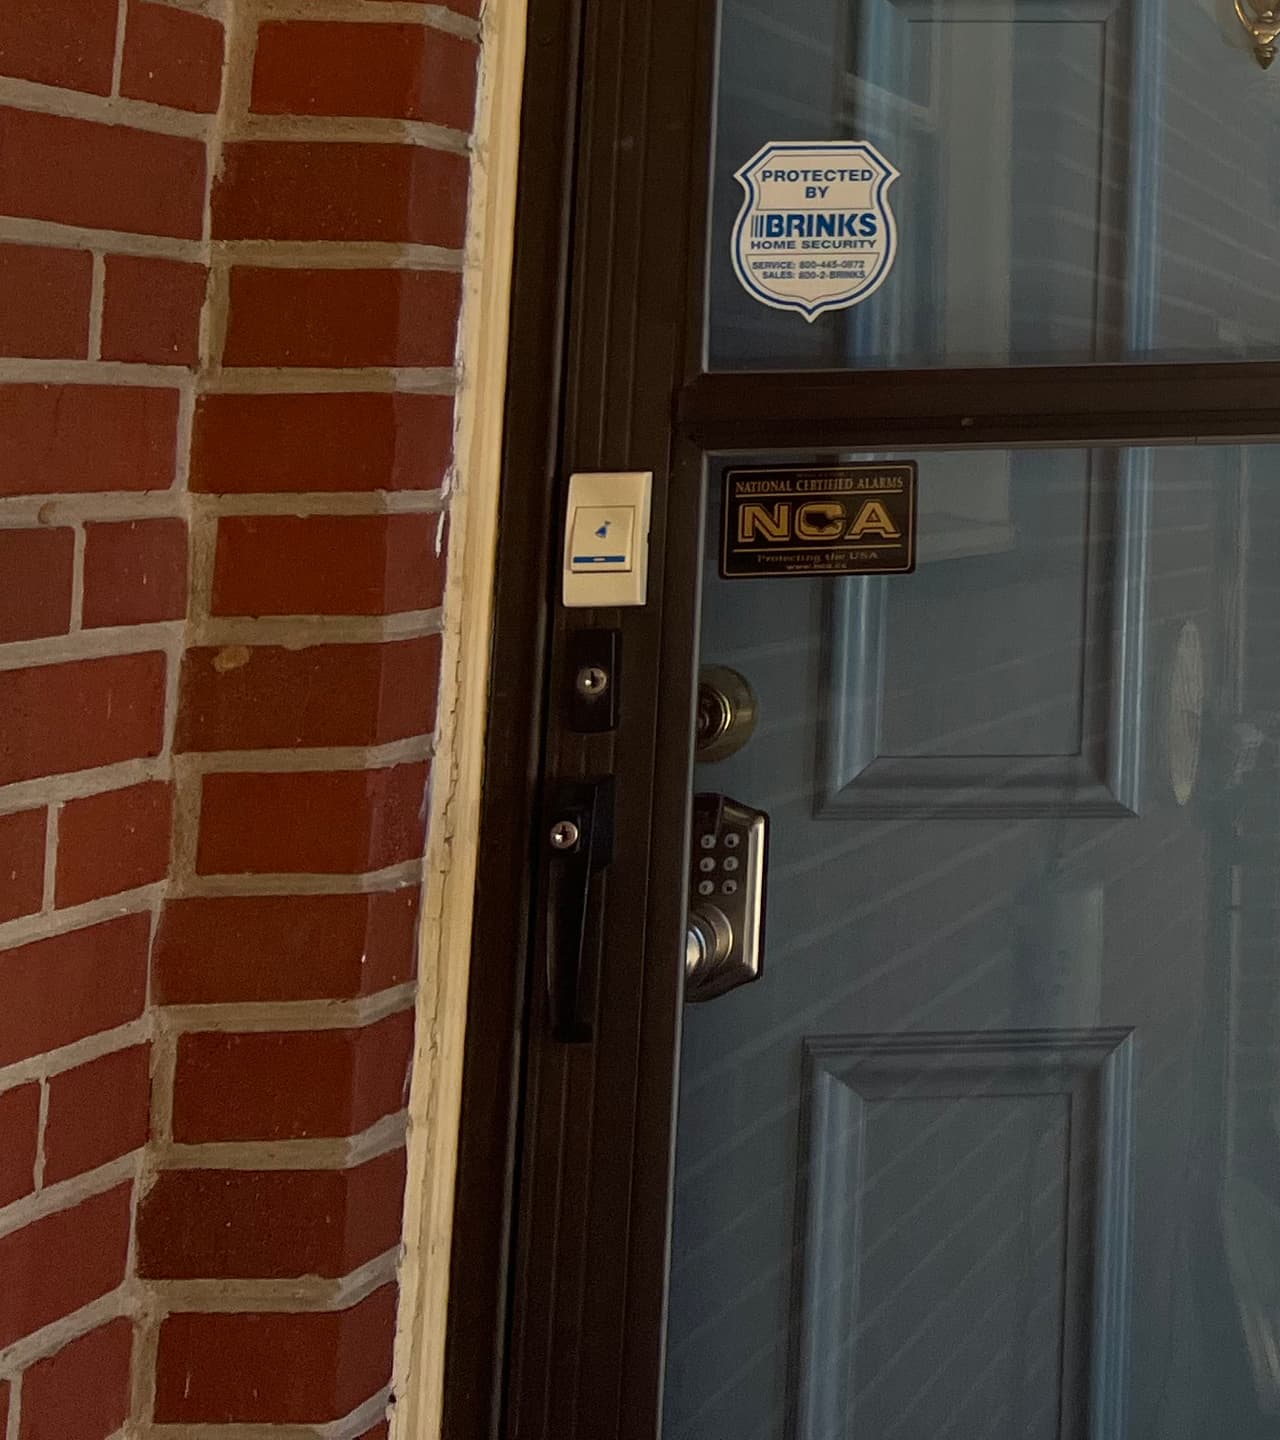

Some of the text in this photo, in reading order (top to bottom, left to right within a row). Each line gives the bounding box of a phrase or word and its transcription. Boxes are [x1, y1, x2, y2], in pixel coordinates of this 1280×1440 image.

[761, 169, 874, 183] PROTECTED
[805, 186, 830, 199] BY
[765, 212, 877, 237] BRINKS
[750, 239, 877, 250] HOME SECURITY
[735, 476, 903, 493] NATIONAL CERTIFIED ALARMS
[737, 498, 902, 543] NCA
[850, 551, 879, 560] USA
